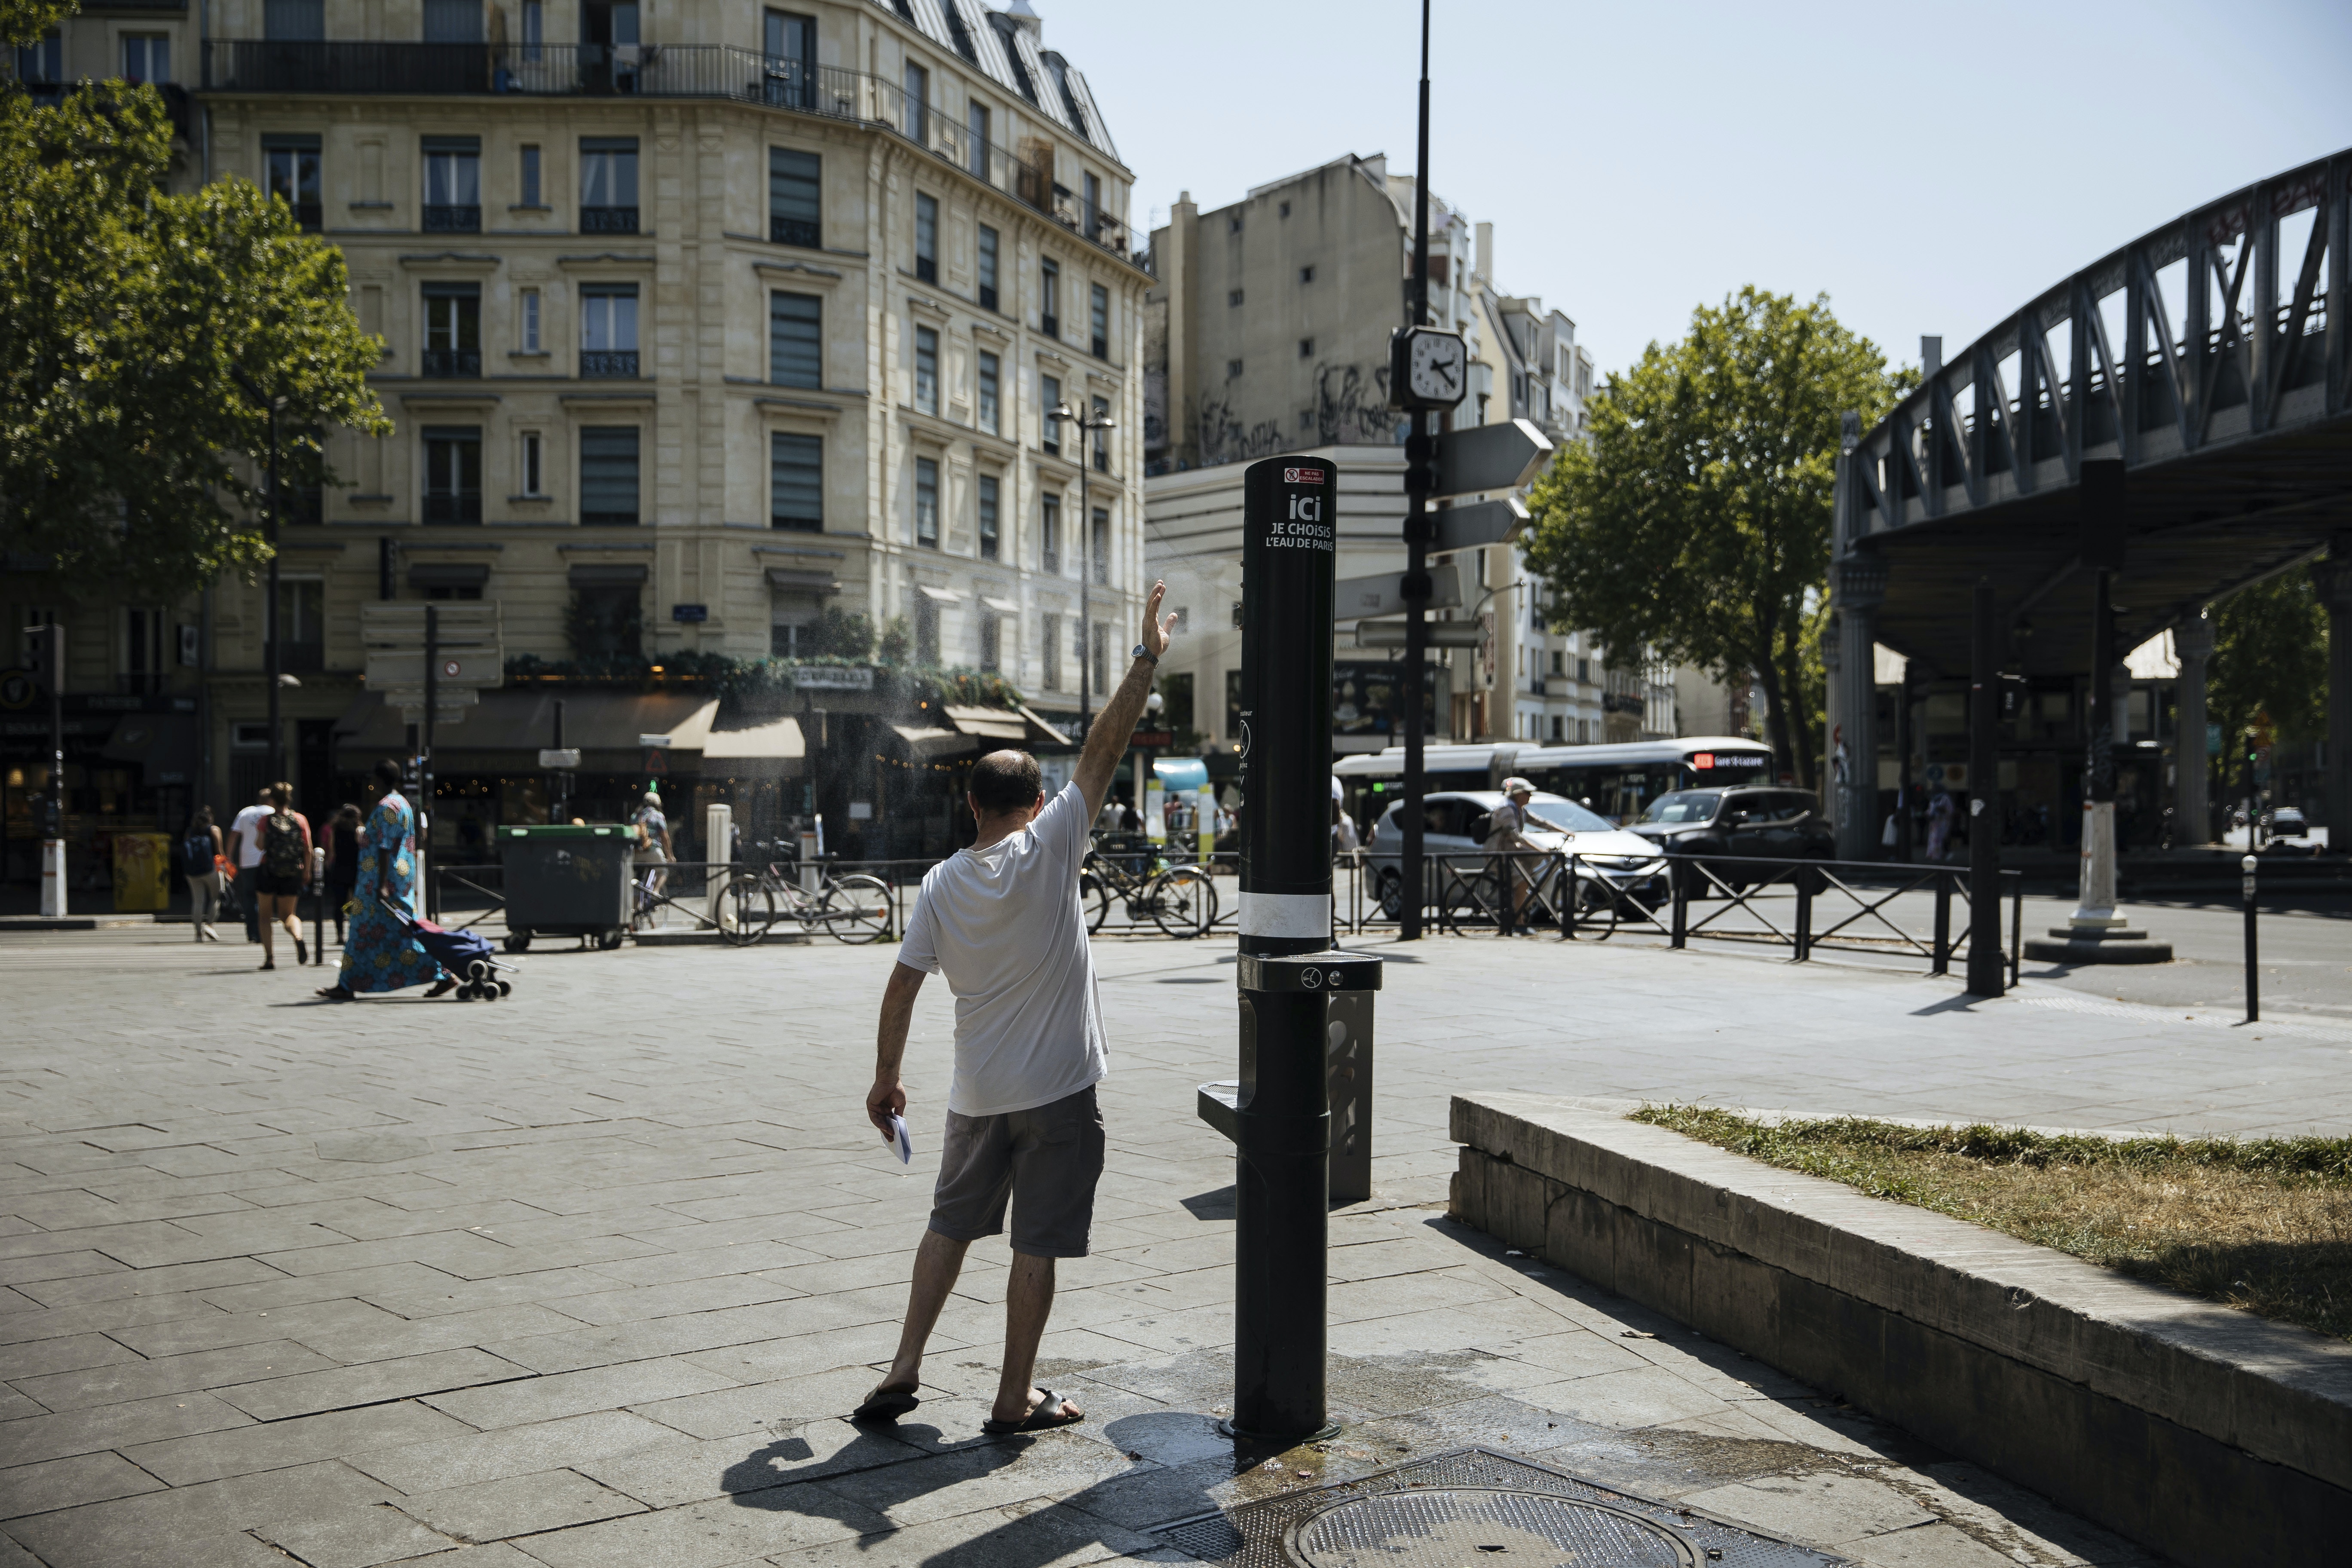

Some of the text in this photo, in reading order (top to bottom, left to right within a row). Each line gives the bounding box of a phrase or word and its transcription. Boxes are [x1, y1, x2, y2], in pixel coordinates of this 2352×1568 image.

[1271, 523, 1284, 534] JE
[1266, 537, 1294, 547] L'EAU
[1297, 538, 1311, 548] DE
